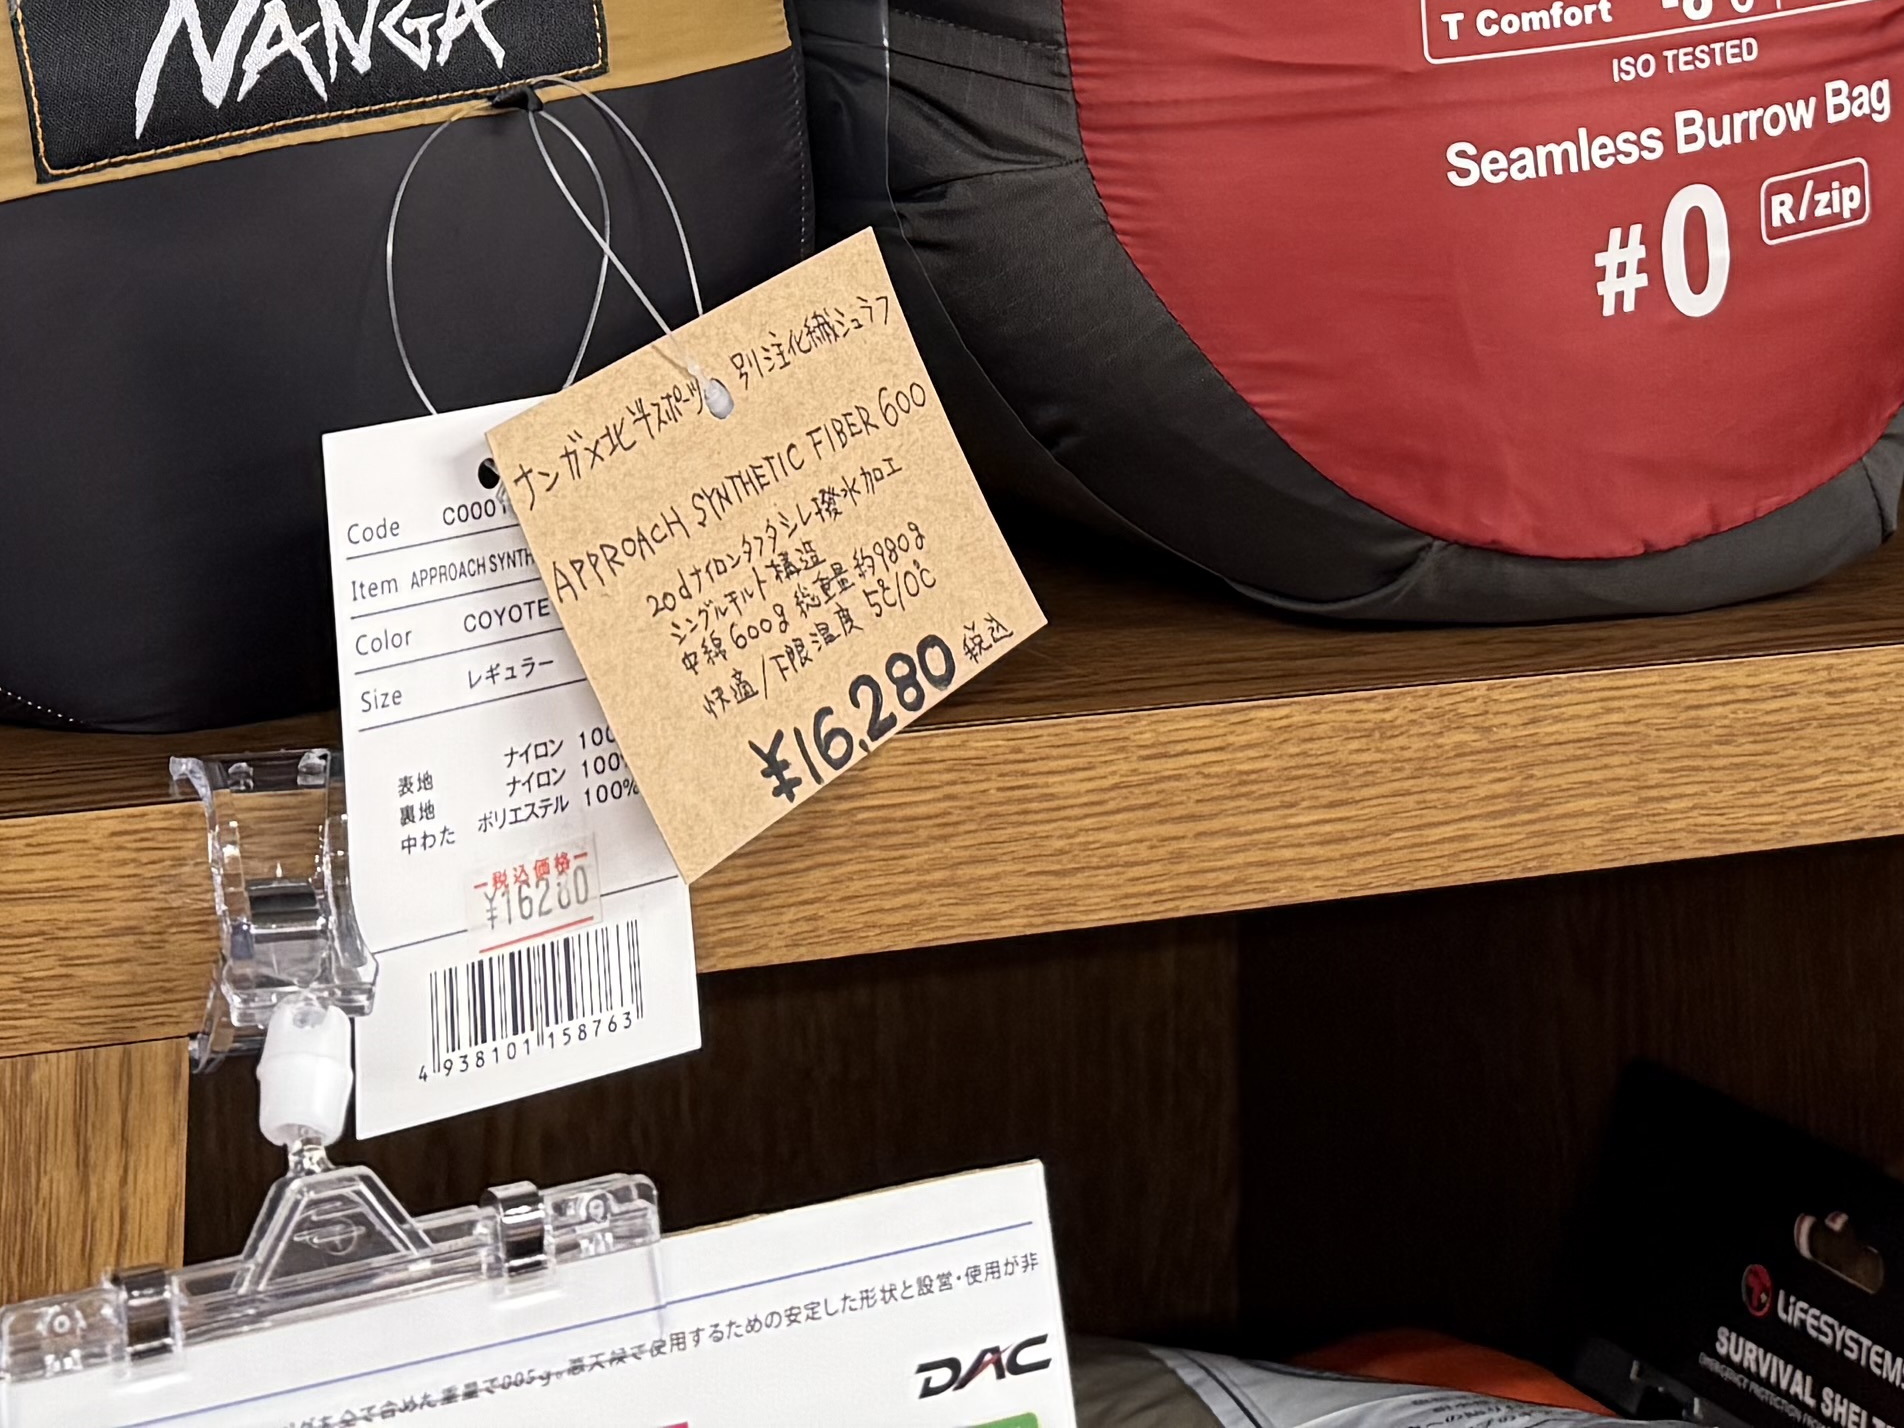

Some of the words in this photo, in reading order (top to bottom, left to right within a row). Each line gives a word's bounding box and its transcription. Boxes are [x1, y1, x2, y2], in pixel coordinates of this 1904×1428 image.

[1441, 12, 1465, 41] T
[1611, 57, 1656, 83] ISO
[1662, 37, 1759, 75] TESTED
[1444, 123, 1665, 190] Seamless
[1672, 97, 1818, 154] Burrow
[1825, 74, 1892, 127] Bag
[1770, 178, 1862, 230] R/zip
[552, 506, 690, 604] APPROACH
[691, 442, 804, 528] SYNTHETIC
[807, 406, 879, 461] FIBER
[877, 382, 926, 427] 600
[347, 517, 400, 544] Code
[351, 576, 398, 601] Item
[411, 555, 486, 590] APPROACH
[355, 628, 412, 656] Color
[464, 598, 550, 633] COYOTE
[361, 688, 402, 712] Size
[468, 657, 554, 689] レギュラー
[749, 634, 956, 803] ¥16,280
[963, 613, 1014, 663] 税込
[398, 770, 433, 798] 表地
[503, 740, 563, 768] ナイロン
[400, 799, 435, 827] 裏地
[506, 767, 565, 797] ナイロン
[582, 755, 626, 778] 100
[401, 824, 455, 855] 中わた
[477, 797, 569, 833] ポリエステル
[584, 777, 640, 807] 100%
[915, 1334, 1053, 1400] DAC
[1715, 1326, 1817, 1407] SURVIVAL
